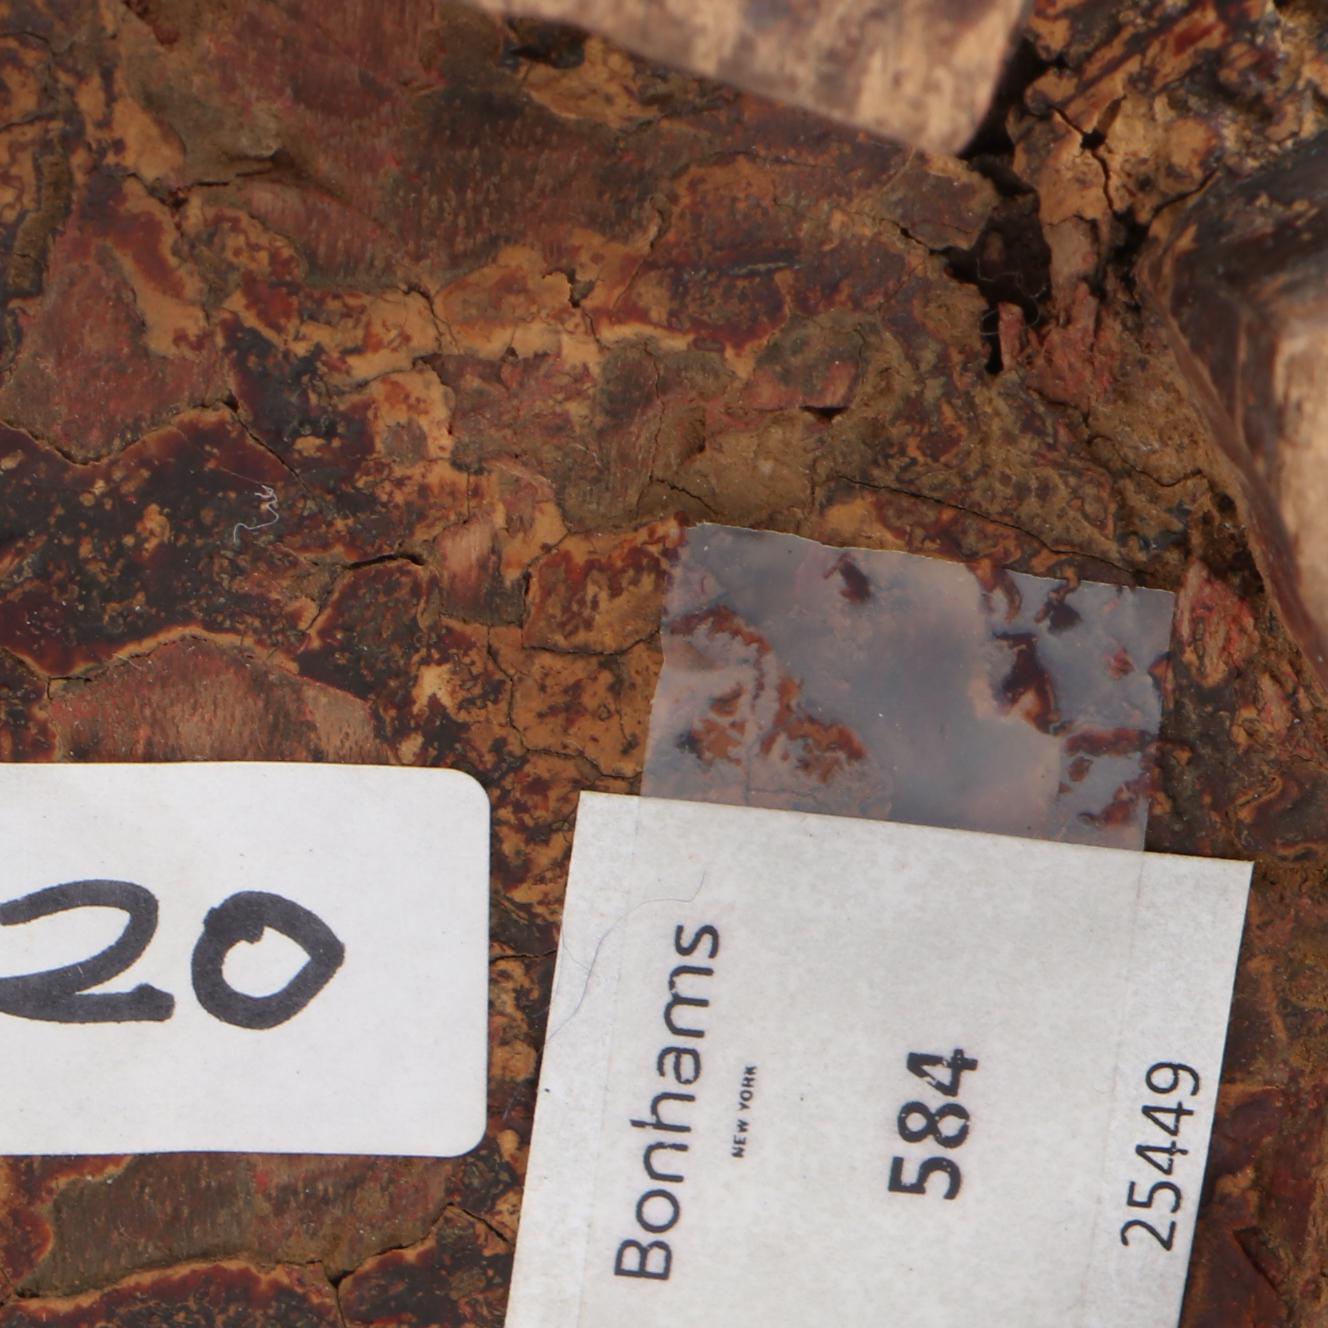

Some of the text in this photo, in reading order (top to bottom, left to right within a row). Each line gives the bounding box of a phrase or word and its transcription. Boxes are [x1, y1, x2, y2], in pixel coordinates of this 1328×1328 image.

[614, 922, 721, 1282] Bonhams
[732, 1065, 758, 1159] NEW YORK
[887, 1047, 980, 1202] 584
[1120, 1061, 1203, 1254] 25449
